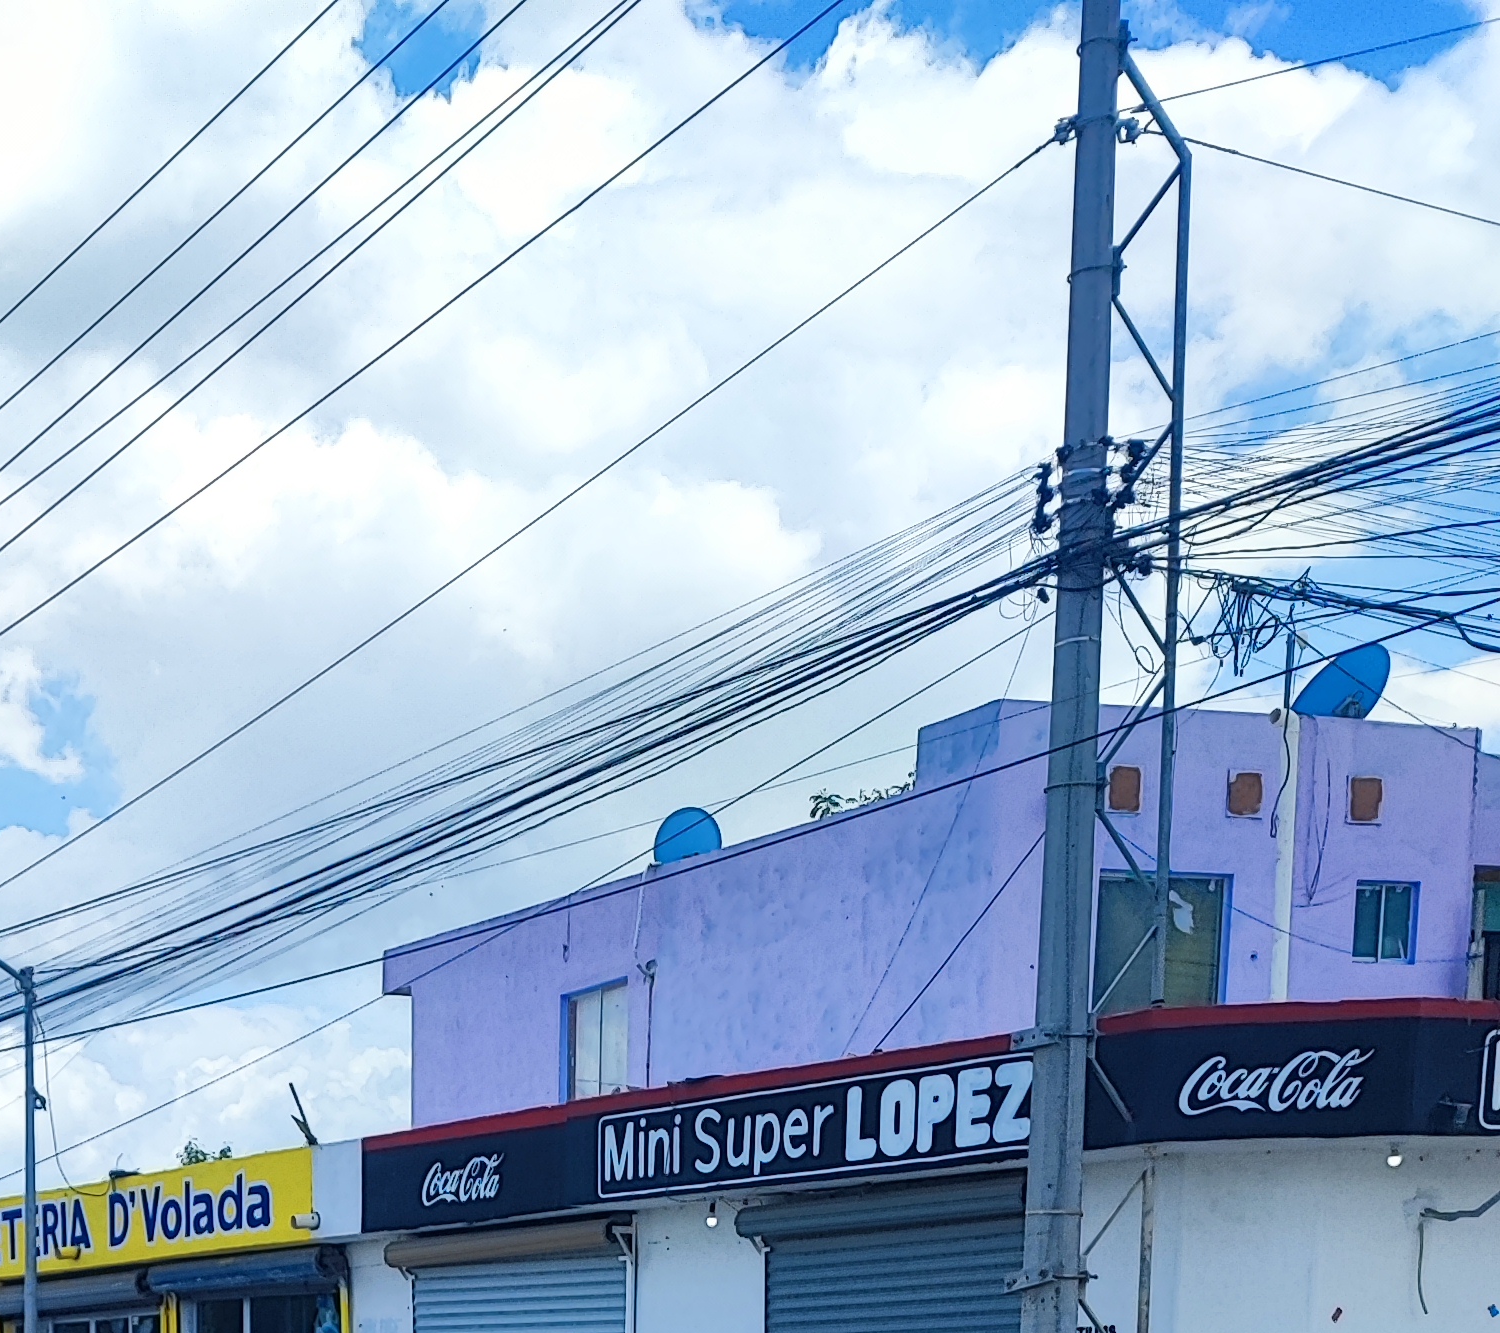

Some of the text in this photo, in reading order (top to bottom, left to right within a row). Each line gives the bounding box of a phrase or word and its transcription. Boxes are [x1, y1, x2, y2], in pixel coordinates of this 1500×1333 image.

[1178, 1048, 1375, 1116] Coca-Cola
[604, 1060, 1034, 1182] Mini Super LOPEZ
[108, 1173, 271, 1247] D'Volada
